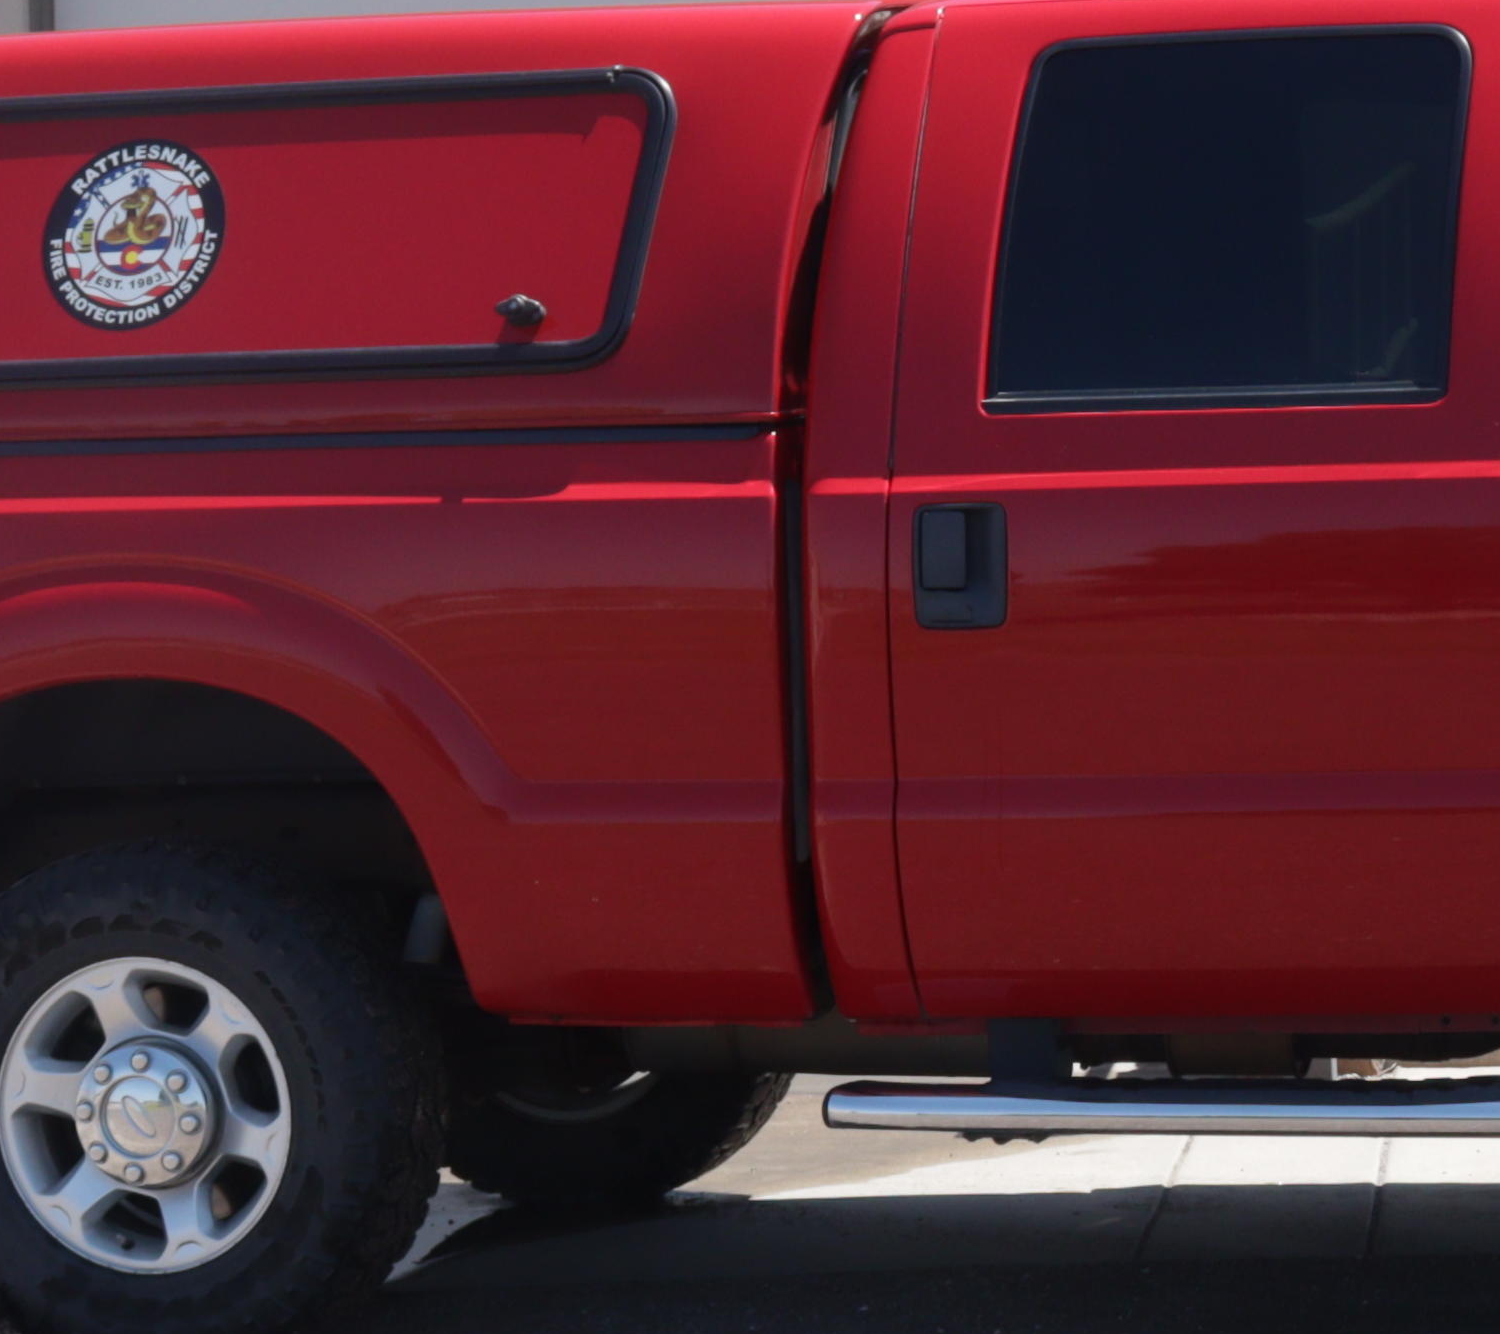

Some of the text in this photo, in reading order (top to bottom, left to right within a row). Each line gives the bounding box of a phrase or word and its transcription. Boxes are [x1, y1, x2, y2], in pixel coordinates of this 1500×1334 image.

[71, 144, 211, 196] RATTLESNAKE
[50, 230, 218, 324] FIRE PROTECTION DISTRICT
[95, 272, 163, 290] EST. 1983
